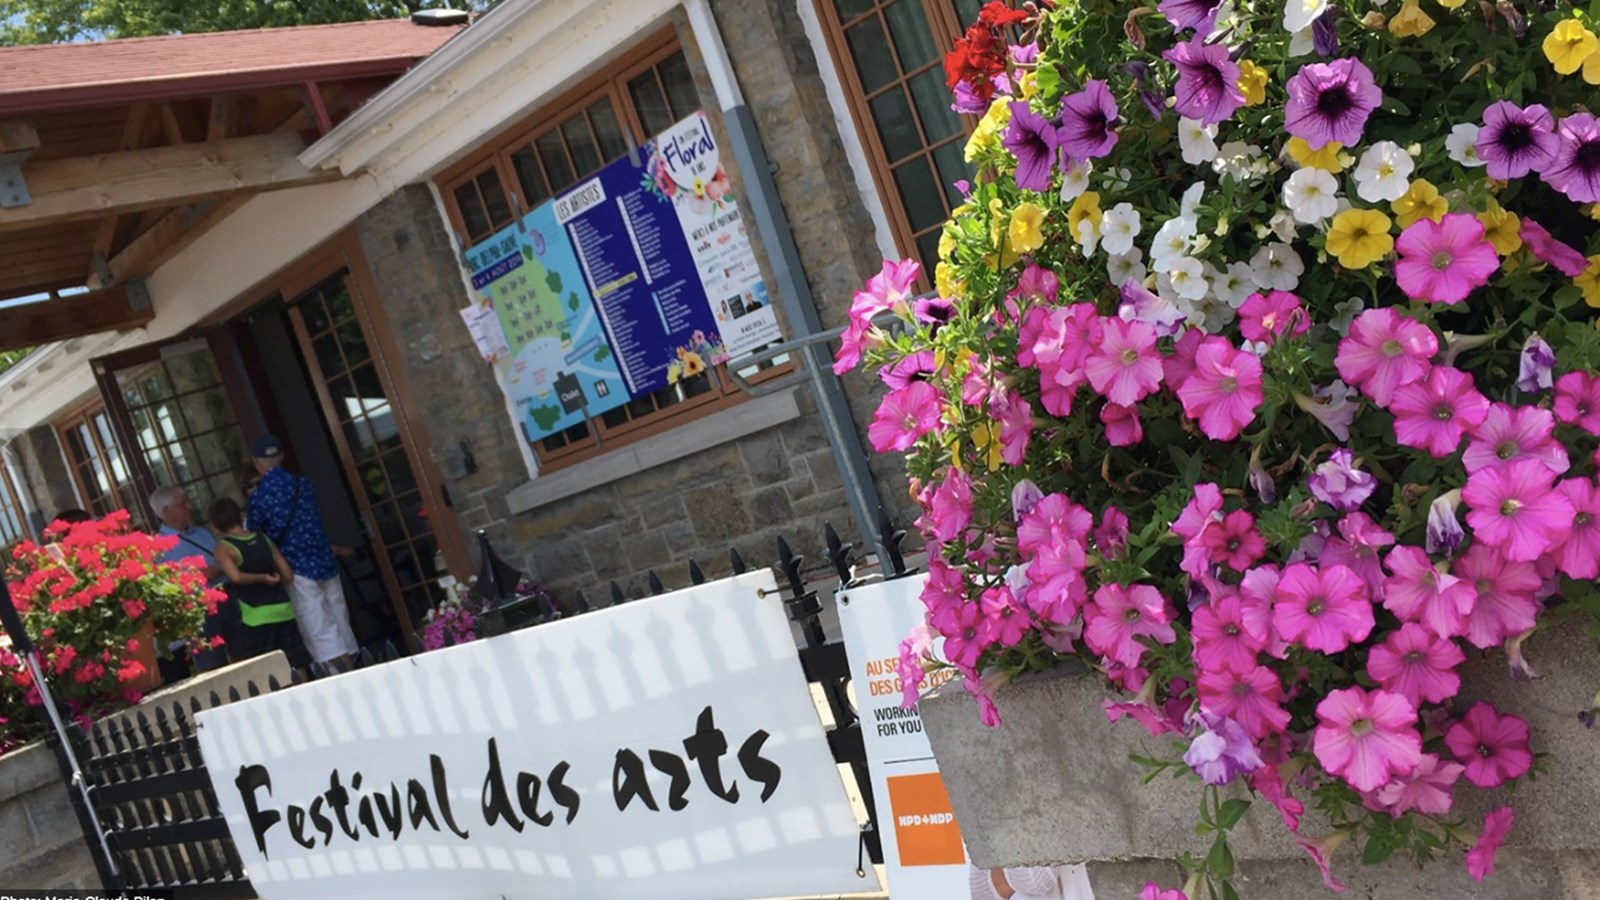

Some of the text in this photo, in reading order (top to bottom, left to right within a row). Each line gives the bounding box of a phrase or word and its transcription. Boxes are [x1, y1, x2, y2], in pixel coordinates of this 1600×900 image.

[663, 118, 714, 173] Floral
[556, 183, 601, 221] LES ARTISTES
[866, 660, 883, 676] AU
[869, 678, 893, 697] DES
[874, 705, 920, 722] WORKIN
[877, 720, 922, 737] FOR YOU
[234, 705, 782, 861] Festival des arts
